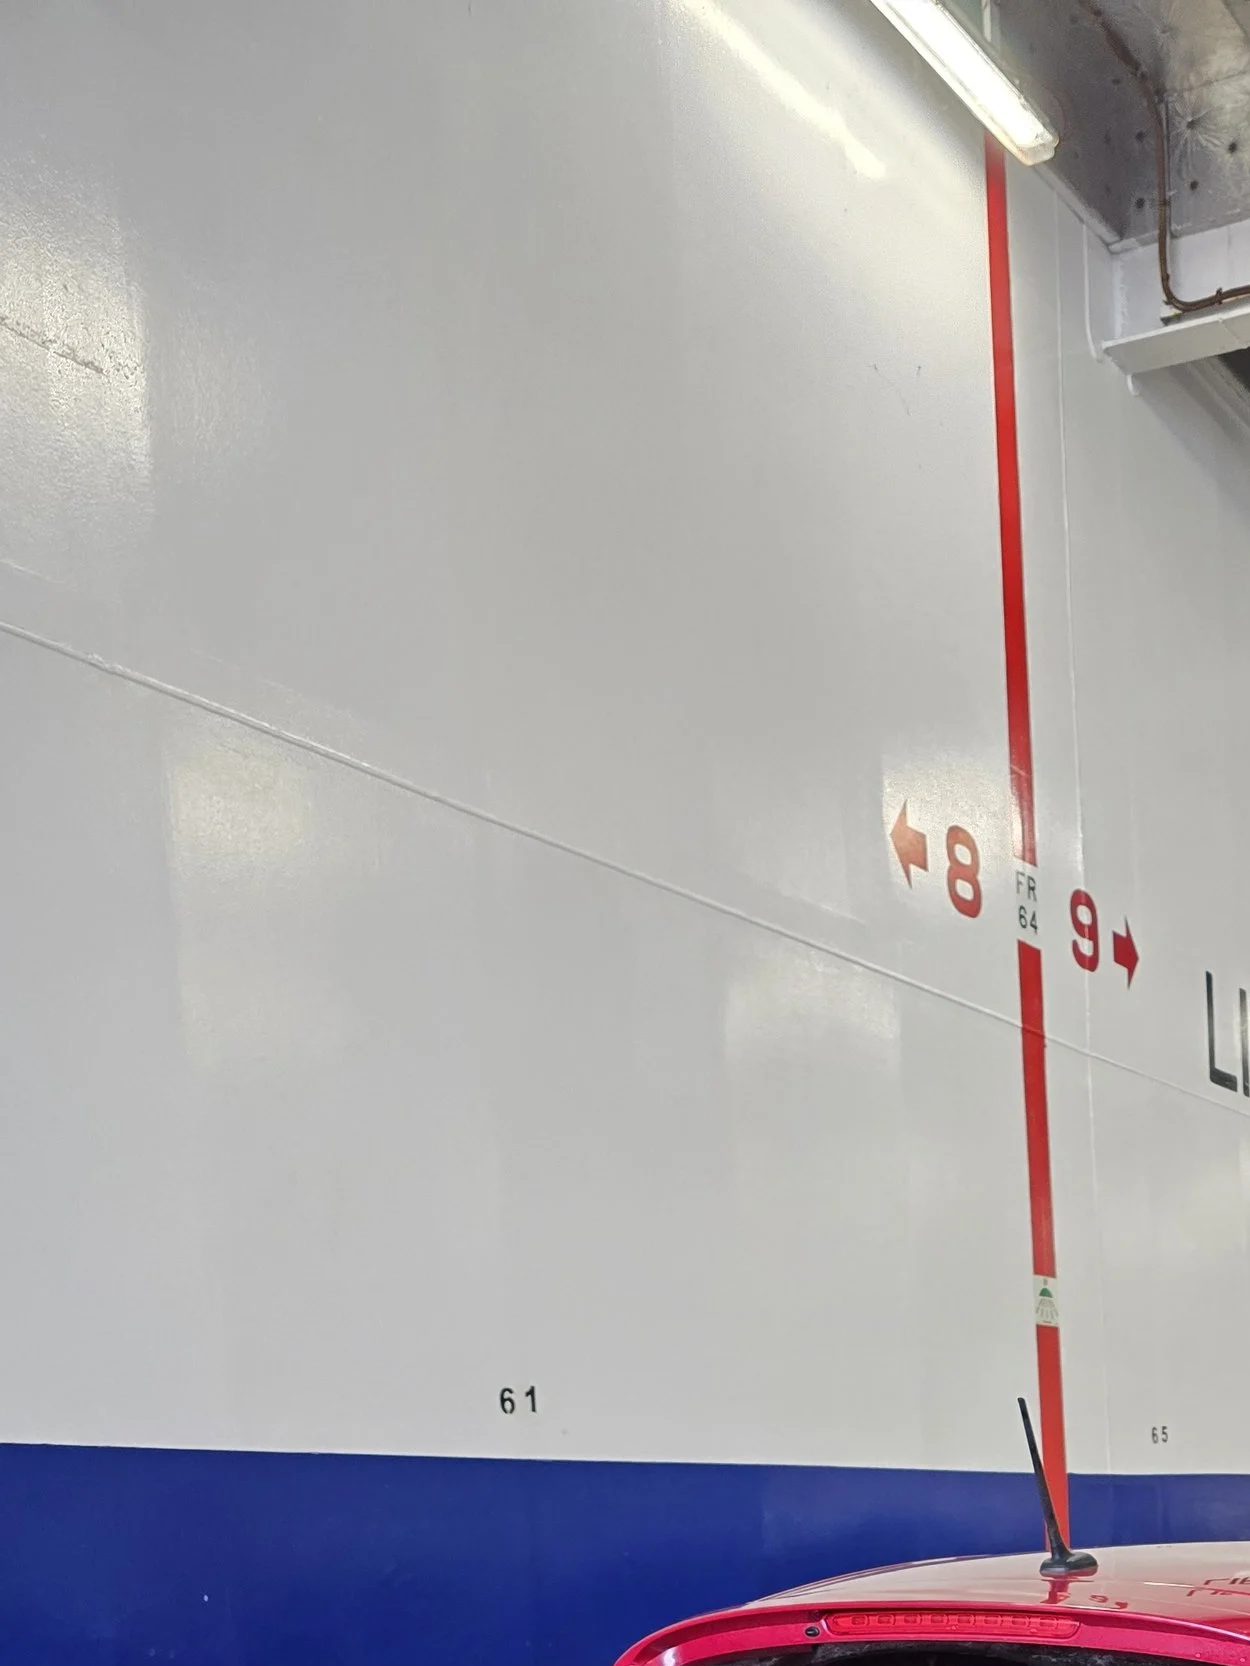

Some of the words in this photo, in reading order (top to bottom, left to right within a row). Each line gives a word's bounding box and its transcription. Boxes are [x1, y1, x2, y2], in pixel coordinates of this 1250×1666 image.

[946, 825, 982, 918] 8
[1016, 870, 1037, 901] FR
[1018, 905, 1037, 934] 64
[1070, 888, 1099, 972] 9
[1151, 1425, 1169, 1444] 65
